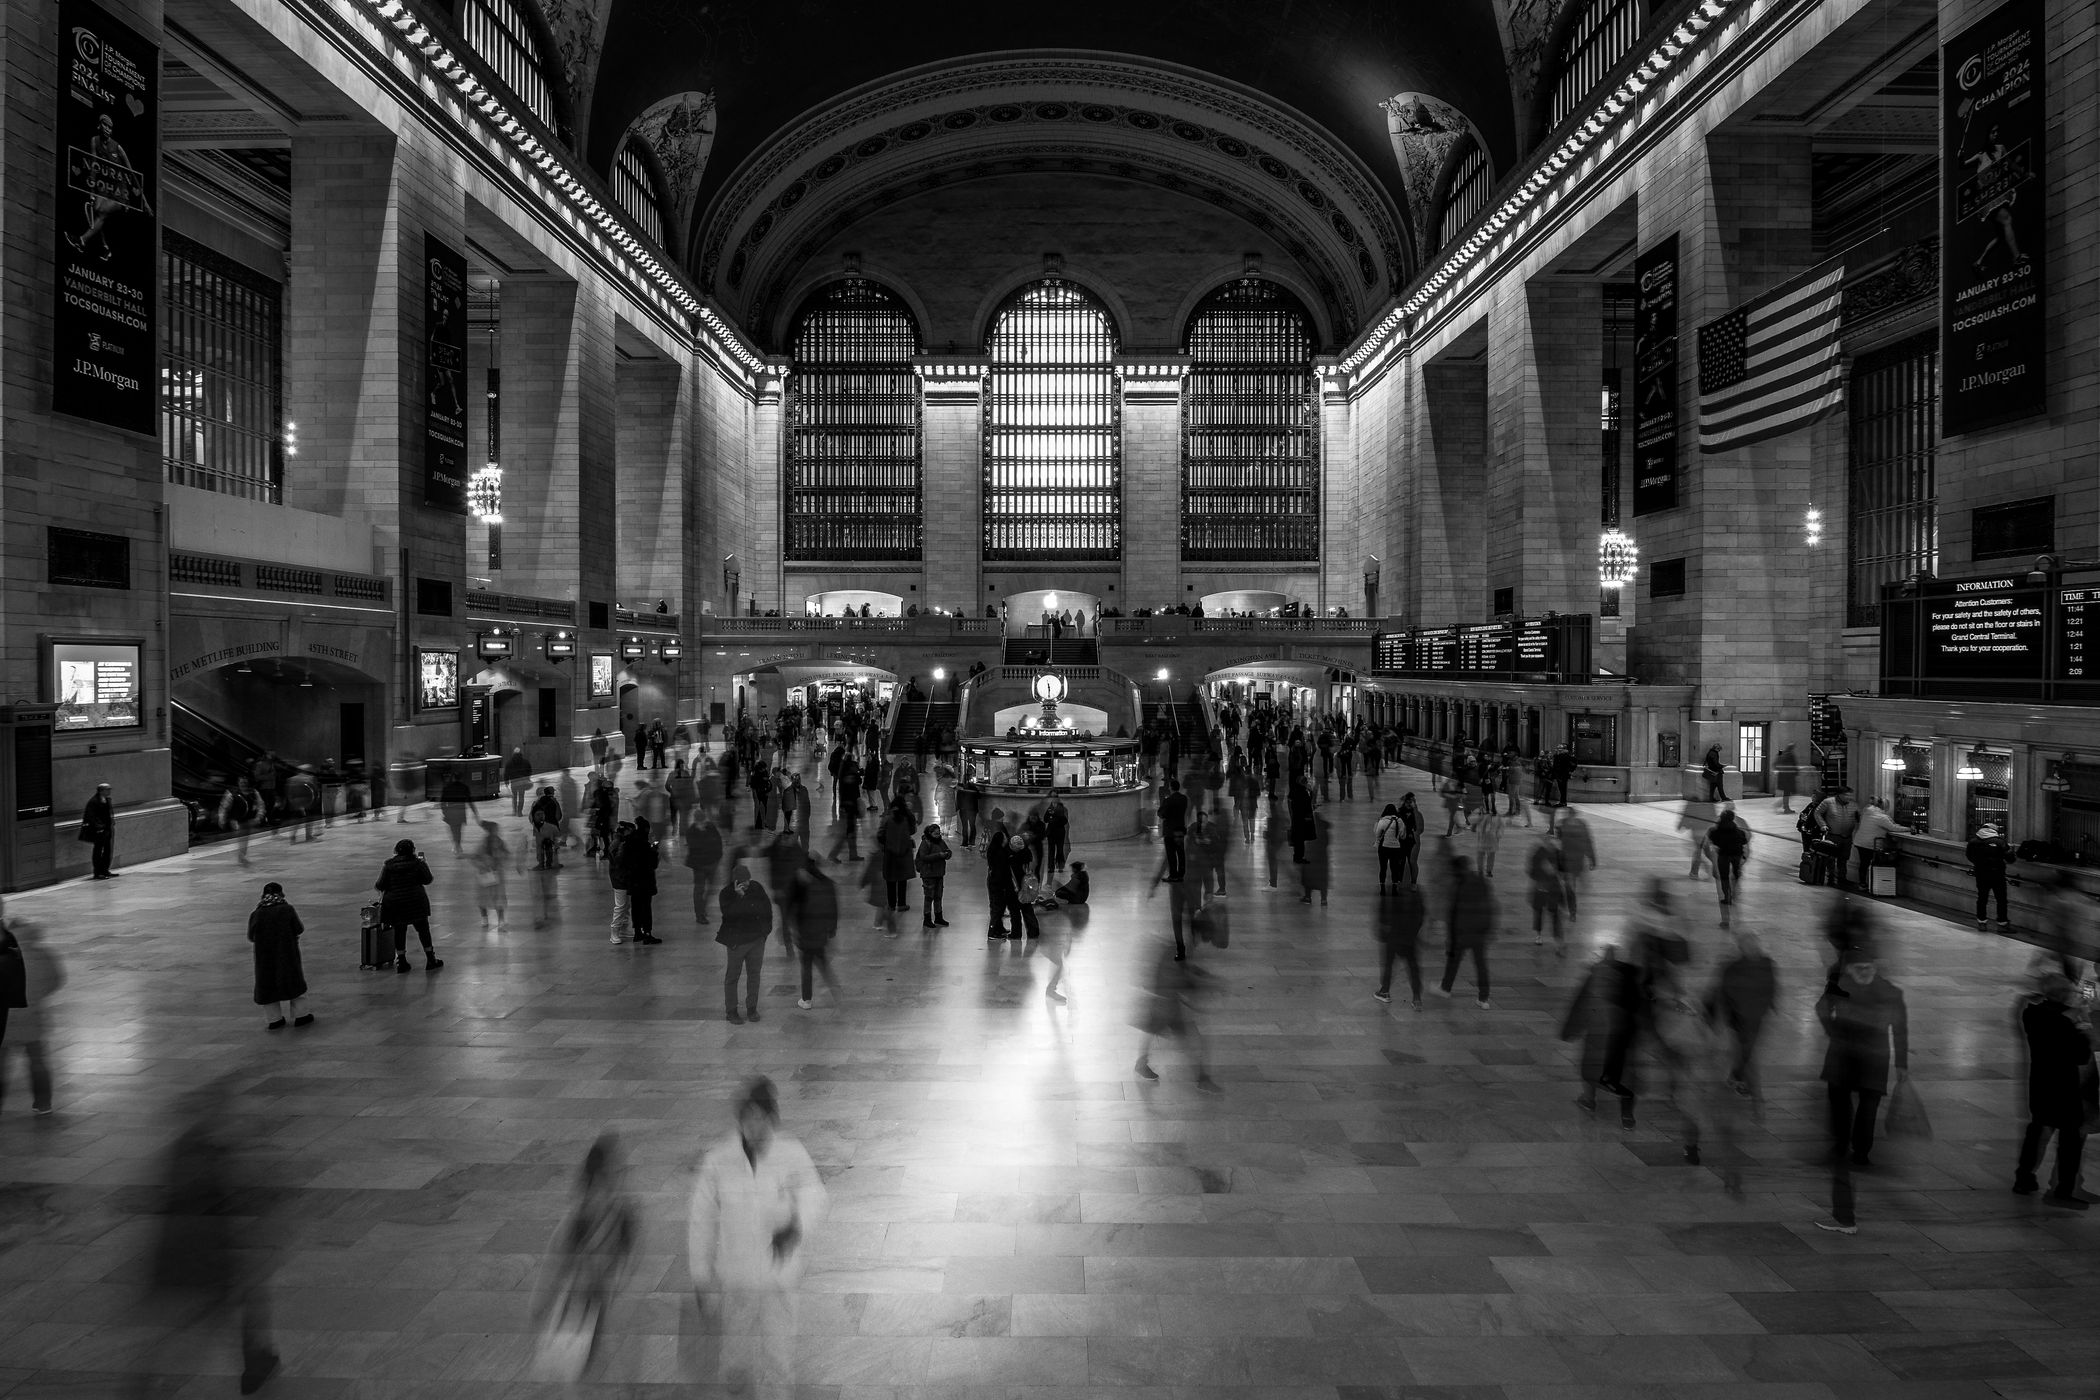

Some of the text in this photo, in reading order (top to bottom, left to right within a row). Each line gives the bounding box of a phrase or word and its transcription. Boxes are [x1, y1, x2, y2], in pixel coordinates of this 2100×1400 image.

[1987, 29, 2031, 61] TOURNAMENT
[1995, 37, 2031, 65] CHAMPIONS
[72, 58, 100, 83] 2024
[104, 51, 146, 82] TOURNAMENT
[104, 60, 146, 91] OF CHAMPIONS
[2003, 58, 2031, 83] 2024
[72, 71, 116, 105] FINALIST
[1975, 70, 2031, 110] CHAMPION
[82, 157, 134, 186] NOURAN
[86, 178, 130, 201] GOHAR
[68, 264, 144, 301] JANUARY 23-30
[1956, 264, 2032, 302] JANUARY 23-30
[2009, 279, 2037, 297] HALL
[64, 276, 148, 318] VANDERBILT HALL
[64, 292, 147, 332] TOCSQUASH.COM
[1952, 293, 2037, 332] TOCSQUASH.COM
[73, 358, 140, 391] J.P.Morgan
[1960, 364, 2026, 392] J.P.Morgan
[1956, 579, 2014, 592] INFORMATION
[2064, 592, 2085, 601] TIME
[1932, 612, 1941, 620] For
[1942, 613, 1953, 621] your
[1955, 611, 1971, 620] safety
[1972, 610, 1983, 618] and
[1994, 609, 2011, 618] safety
[2013, 608, 2019, 616] of
[2020, 607, 2042, 616] others,
[1955, 598, 2013, 607] Attention Customers:
[1932, 623, 1950, 632] please
[1984, 621, 1994, 629] the
[1995, 620, 2008, 628] floor
[2017, 619, 2033, 627] stairs
[2034, 619, 2040, 627] in
[1951, 632, 2018, 641] Grand Central Terminal.
[2067, 630, 2084, 638] 12:44
[170, 641, 280, 680] THE METLIFE BUILDING
[330, 645, 359, 663] STREET
[826, 652, 864, 662] LEXINGTON
[1226, 654, 1264, 665] LEXINGTON
[1941, 644, 2028, 653] Thank you for your cooperation.
